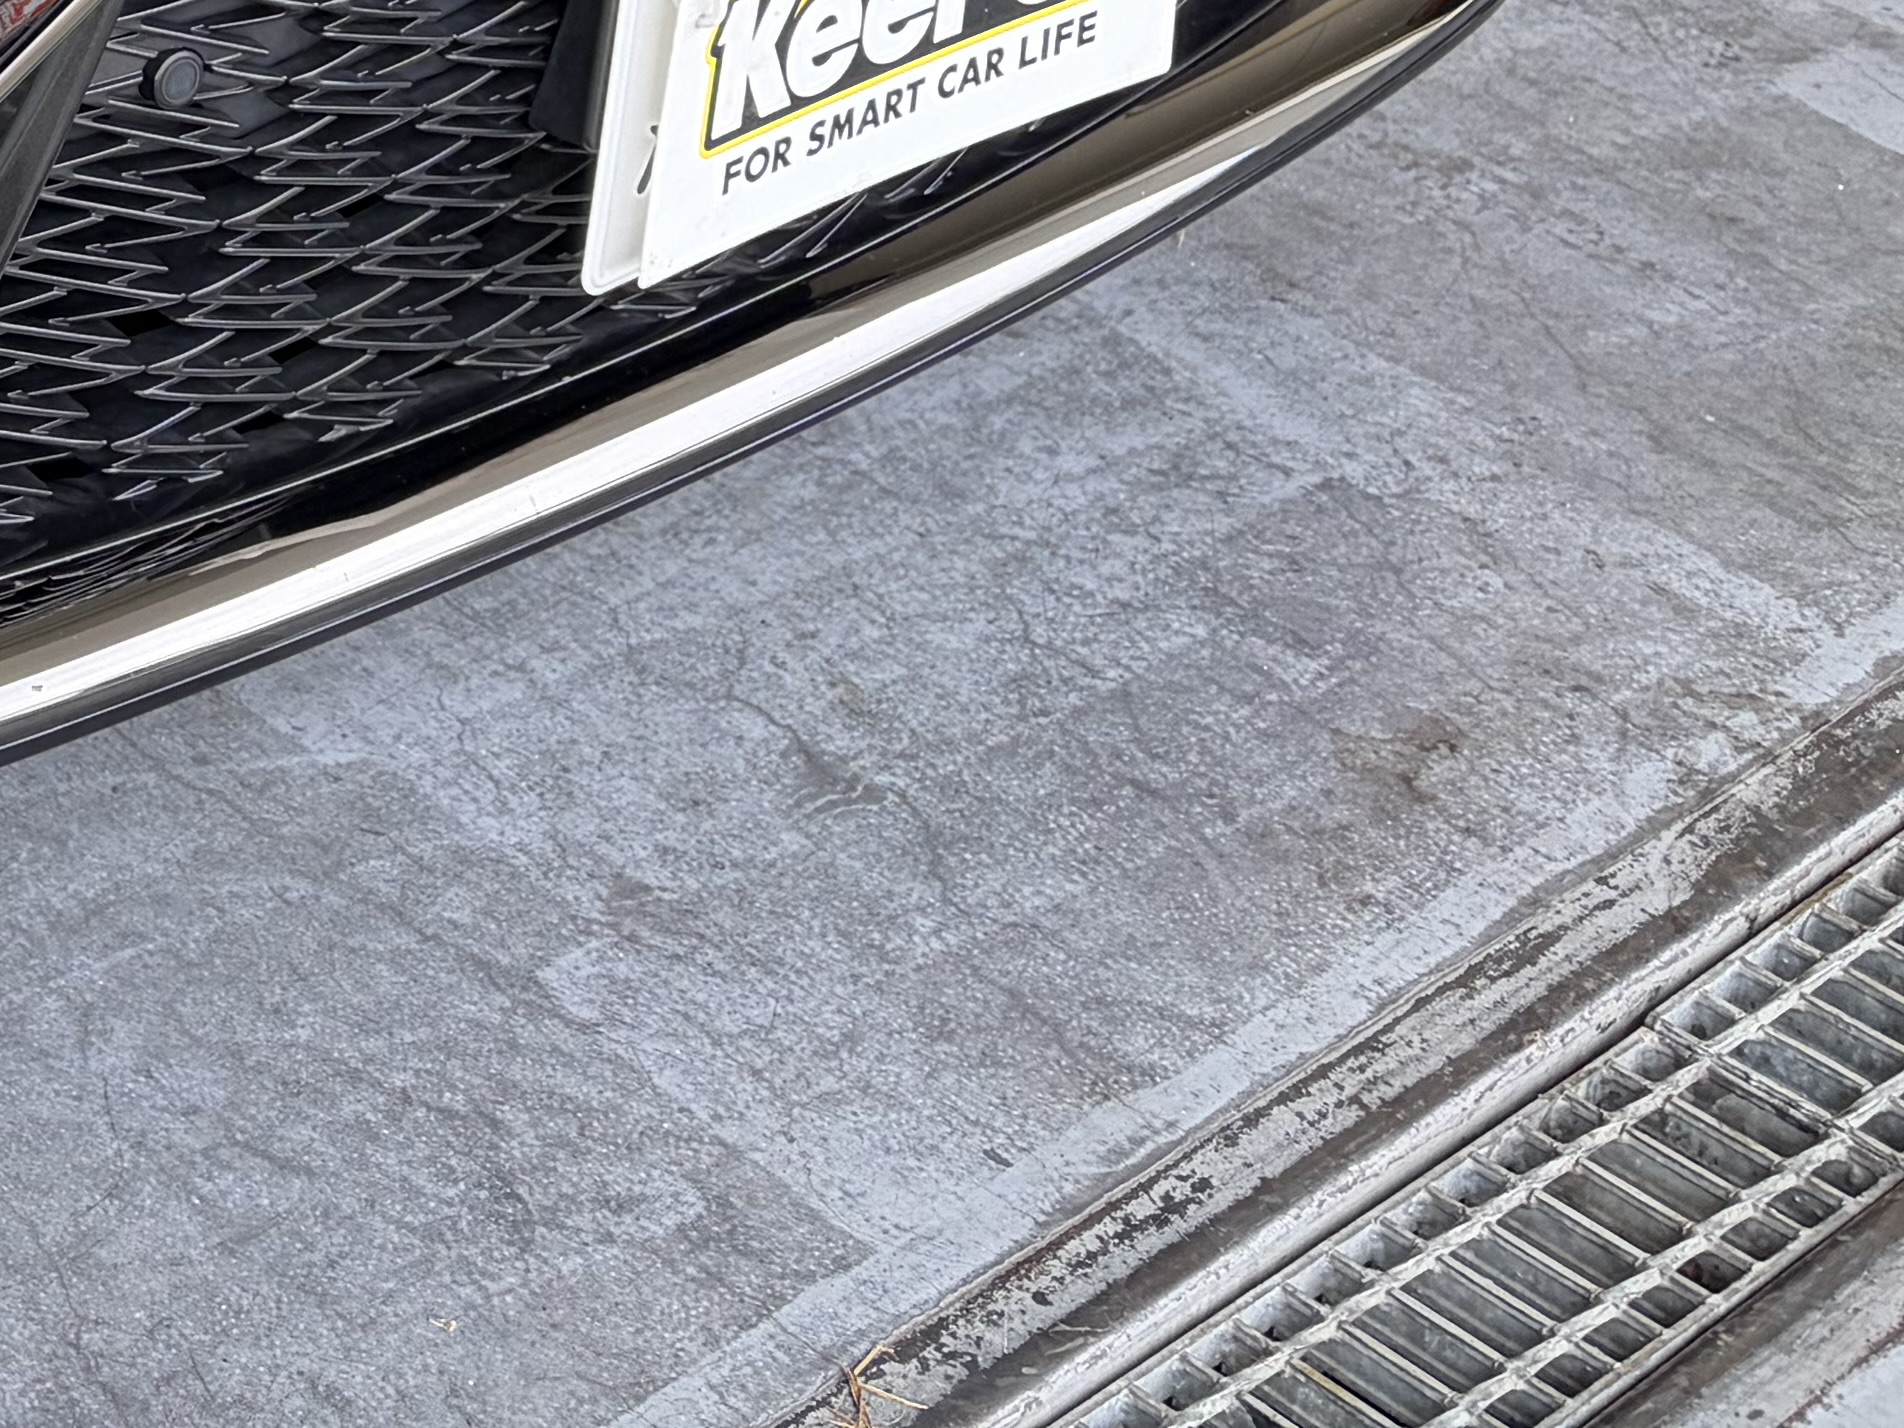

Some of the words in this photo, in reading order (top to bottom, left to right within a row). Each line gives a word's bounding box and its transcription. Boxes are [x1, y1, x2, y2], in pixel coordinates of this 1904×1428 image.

[721, 136, 792, 196] FOR
[805, 77, 926, 157] SMART
[937, 46, 1004, 100] CAR
[1018, 10, 1099, 70] LIFE
